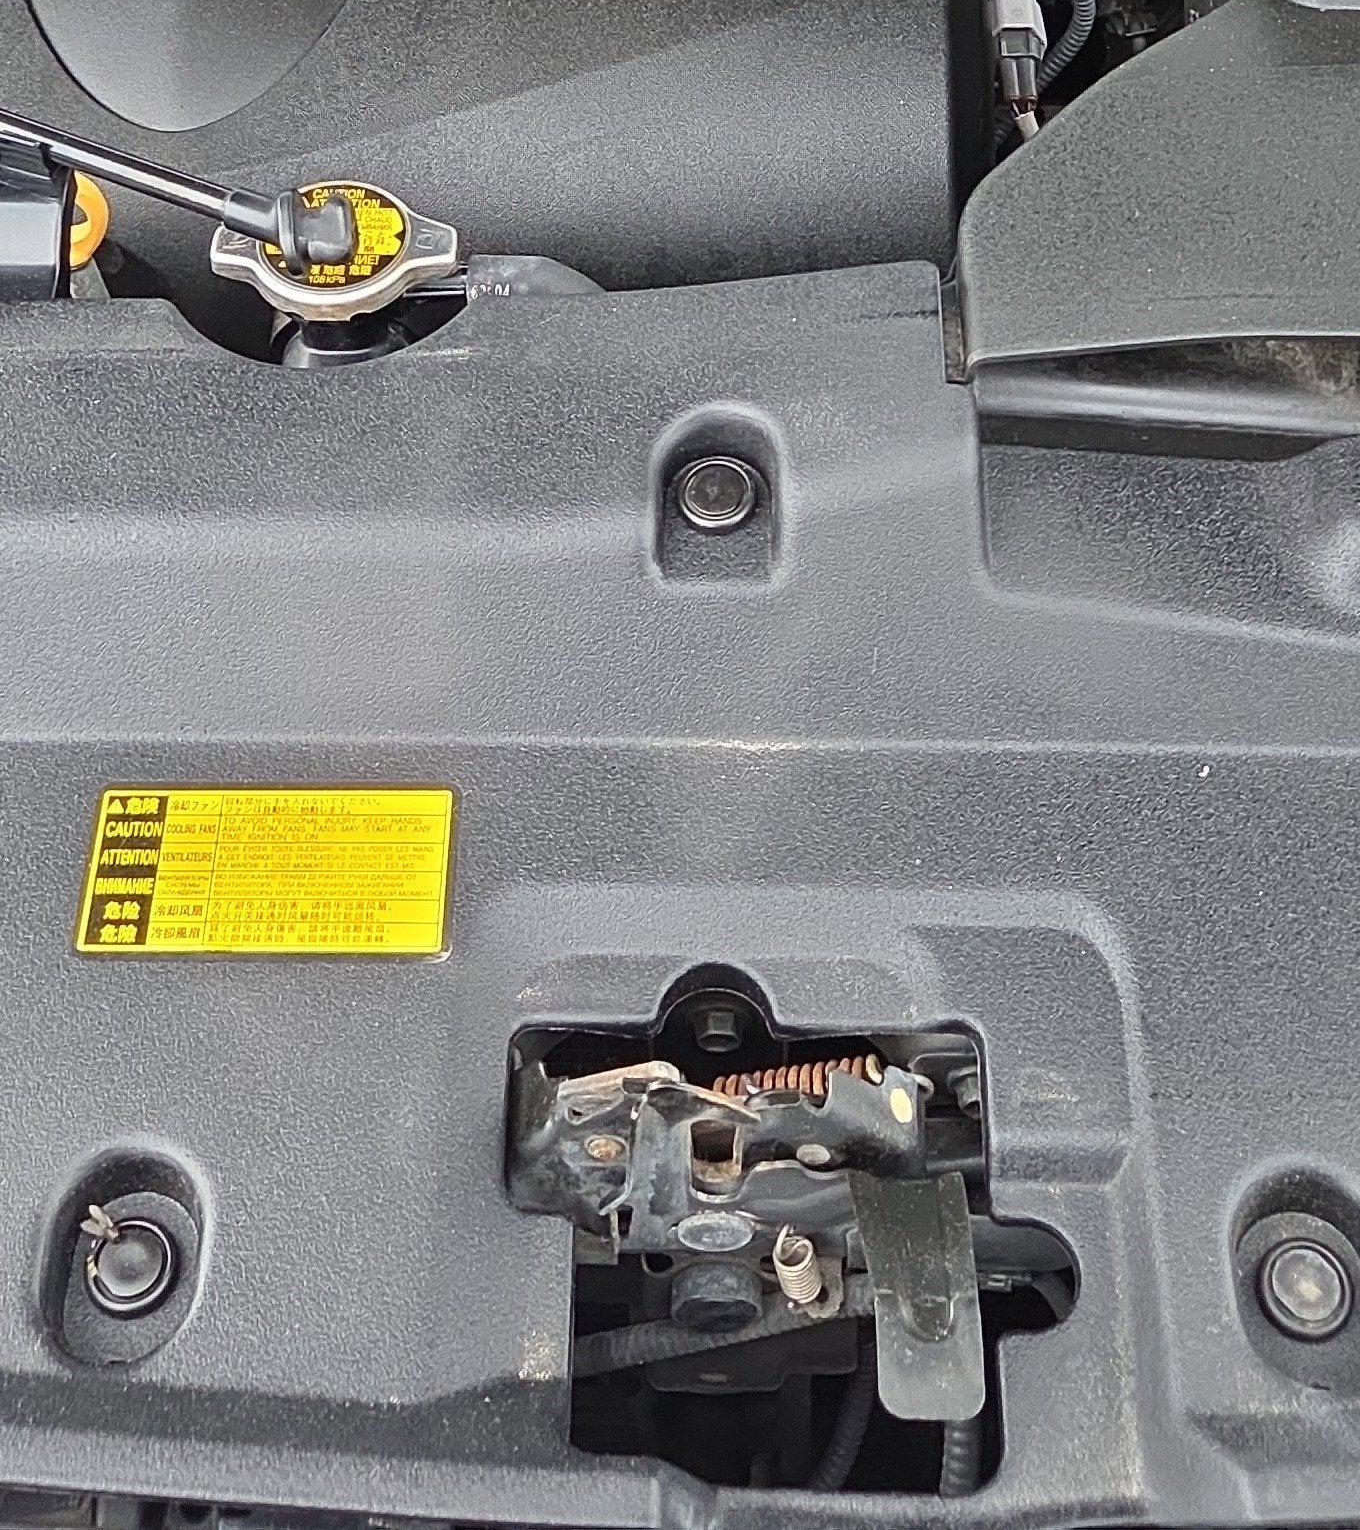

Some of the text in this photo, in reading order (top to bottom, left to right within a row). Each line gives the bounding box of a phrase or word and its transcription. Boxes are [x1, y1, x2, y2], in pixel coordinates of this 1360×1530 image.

[105, 821, 164, 837] CAUTION
[167, 824, 217, 834] COOLING FANS
[100, 849, 160, 865] ATTENTION
[162, 852, 213, 862] VENTILATEURS
[95, 877, 155, 895] ВНИМАНИЕ
[154, 905, 203, 916] 冷却风扇
